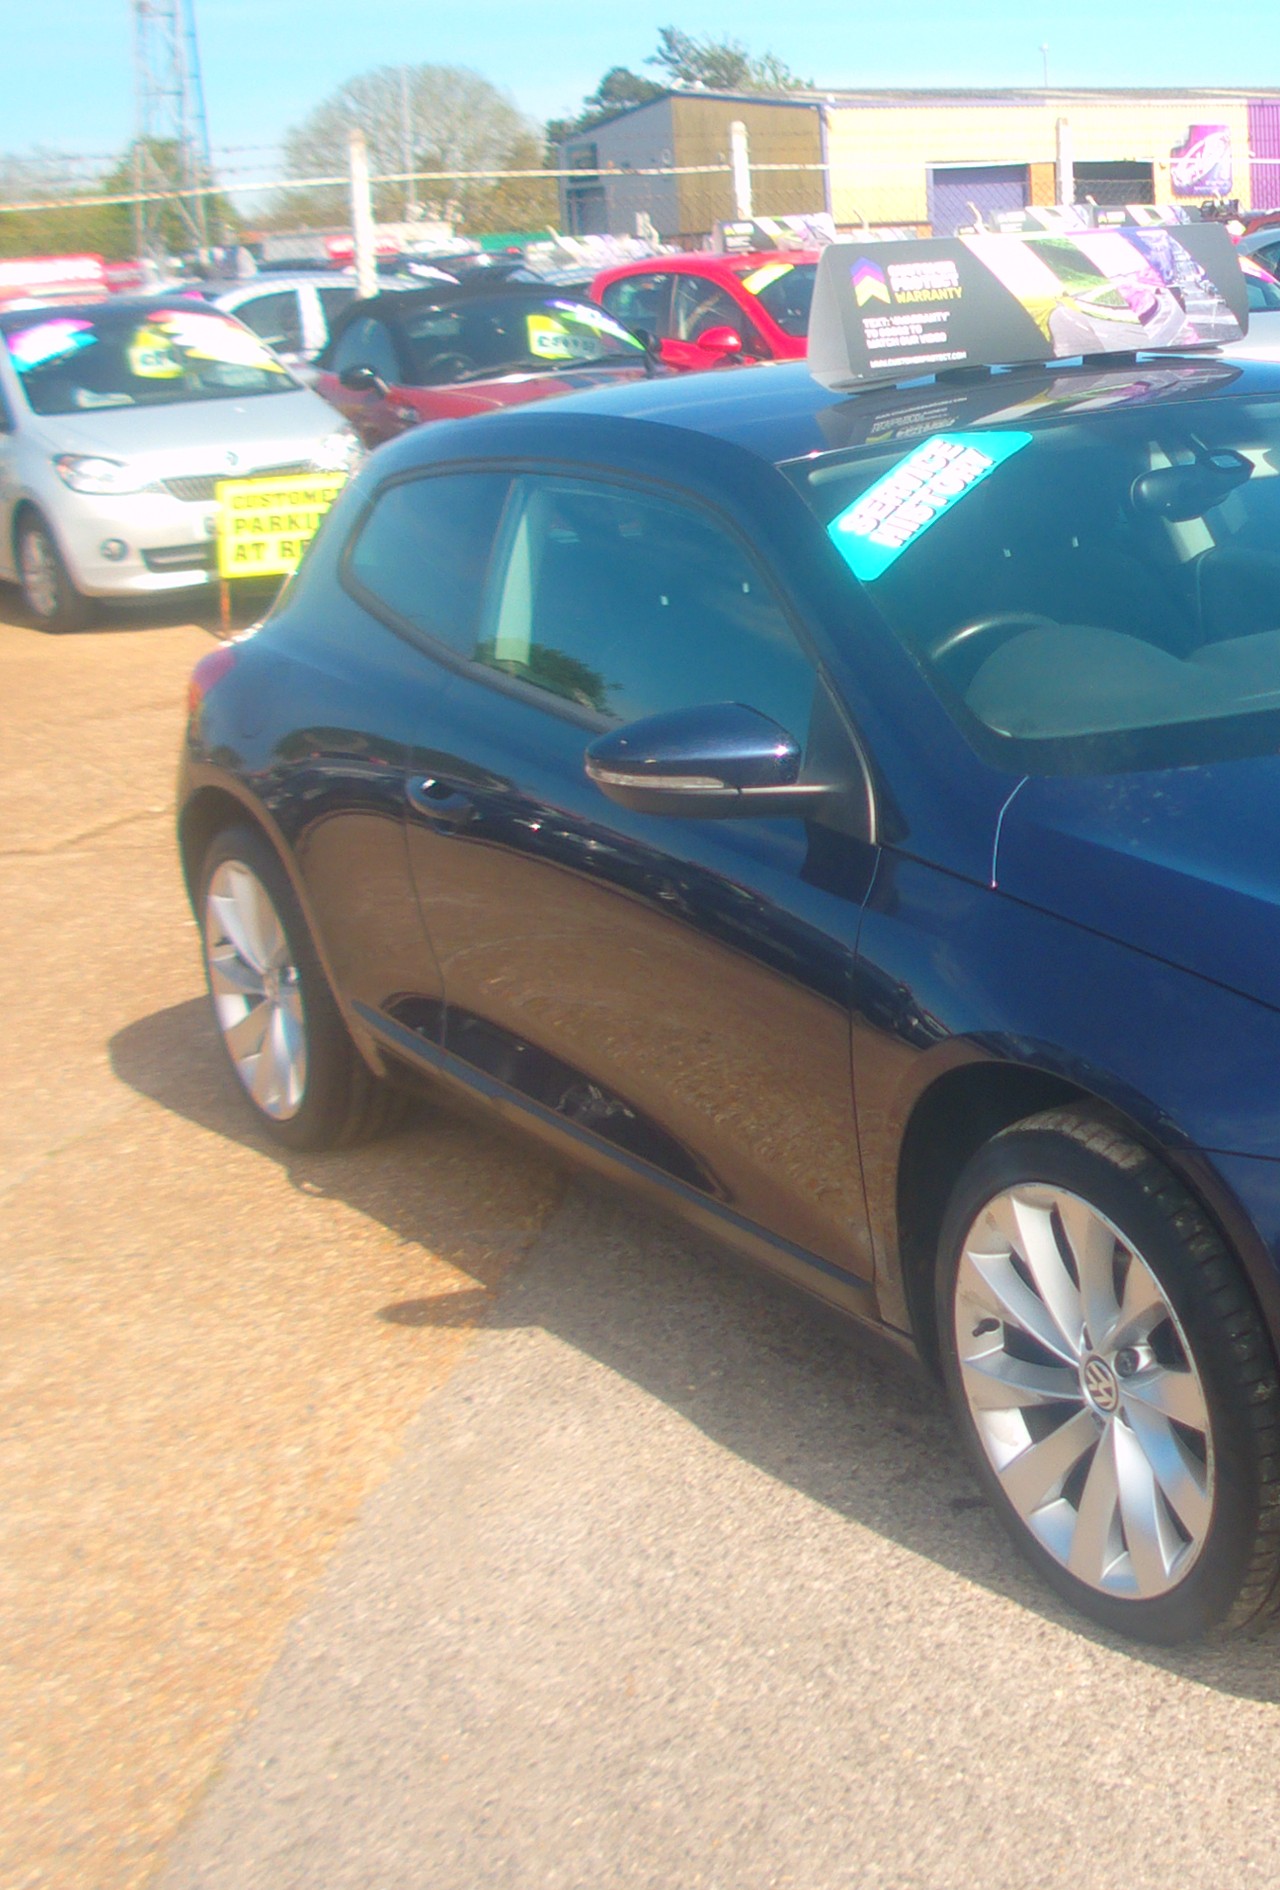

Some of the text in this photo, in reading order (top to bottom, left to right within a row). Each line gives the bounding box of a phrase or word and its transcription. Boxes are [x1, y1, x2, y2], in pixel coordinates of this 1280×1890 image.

[895, 287, 962, 304] WARRANTY
[838, 439, 967, 535] SERVICE
[869, 447, 996, 547] HISTORY
[234, 543, 264, 561] AT
